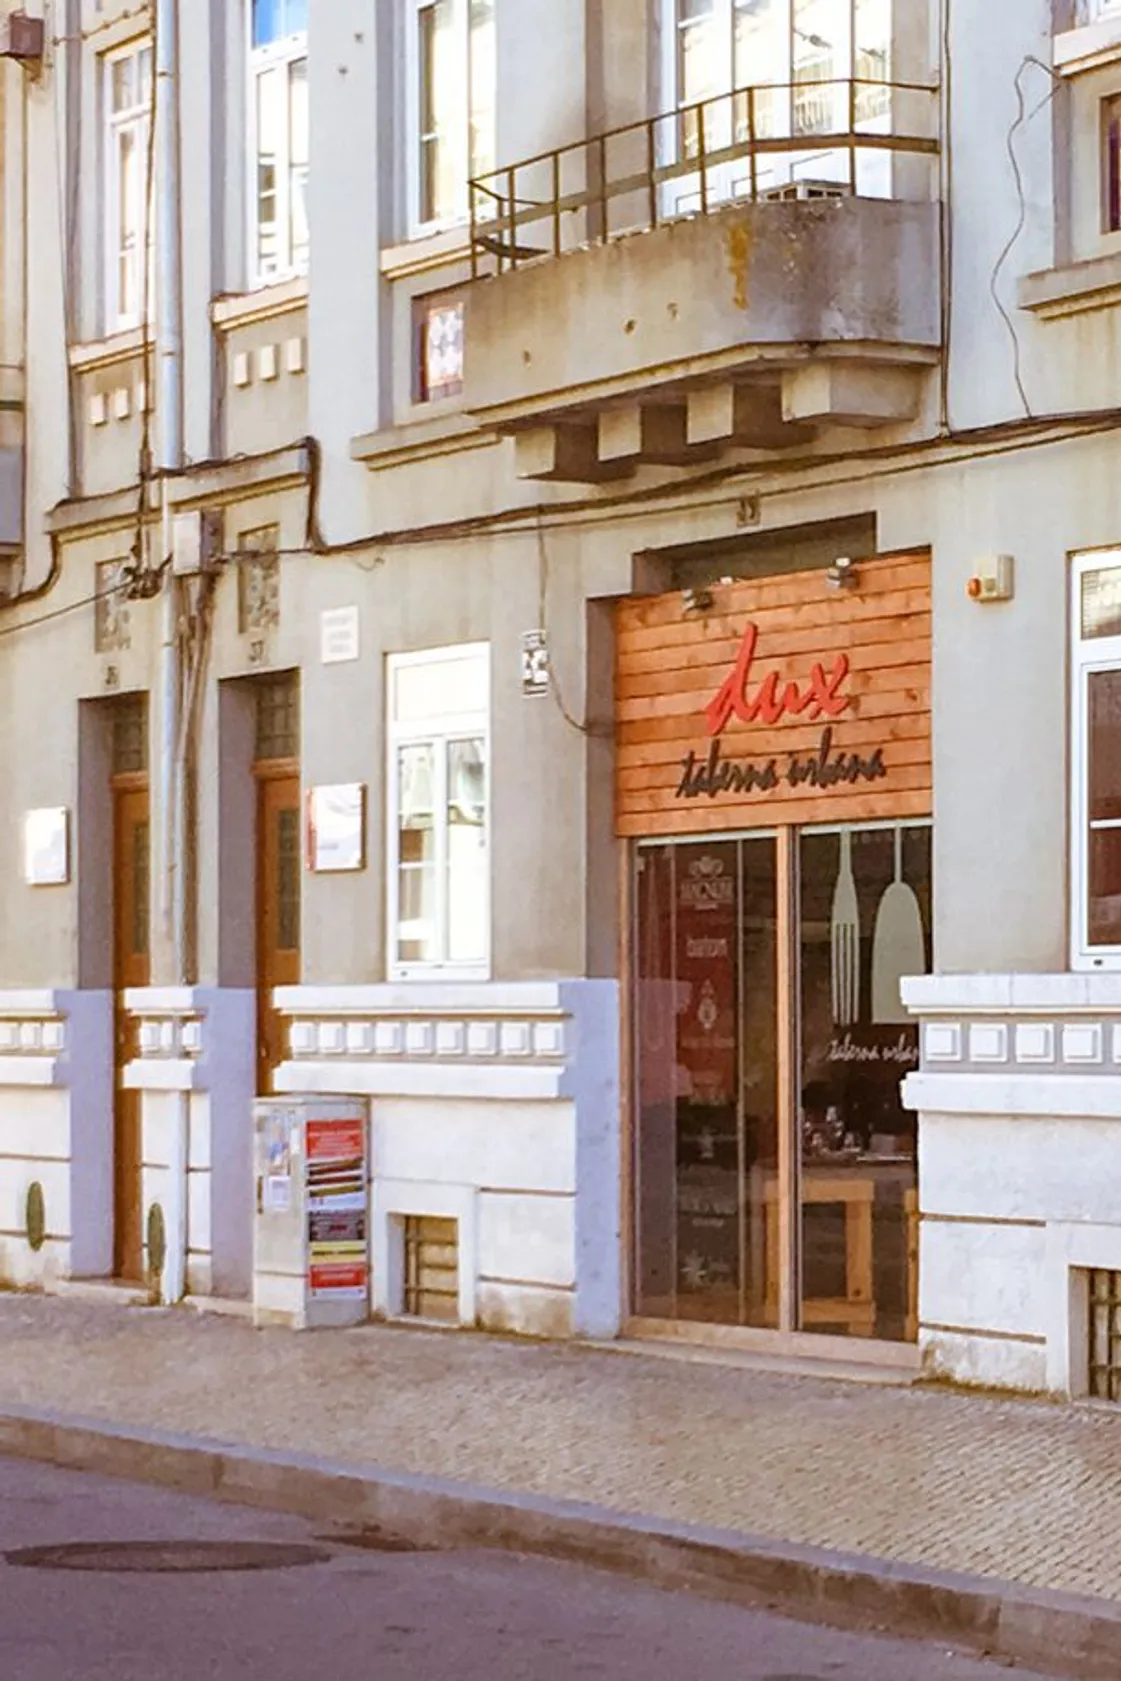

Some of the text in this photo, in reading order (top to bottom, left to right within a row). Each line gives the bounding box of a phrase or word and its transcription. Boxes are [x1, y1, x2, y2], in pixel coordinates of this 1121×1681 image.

[706, 621, 850, 737] dux
[676, 726, 887, 798] taberna urbana
